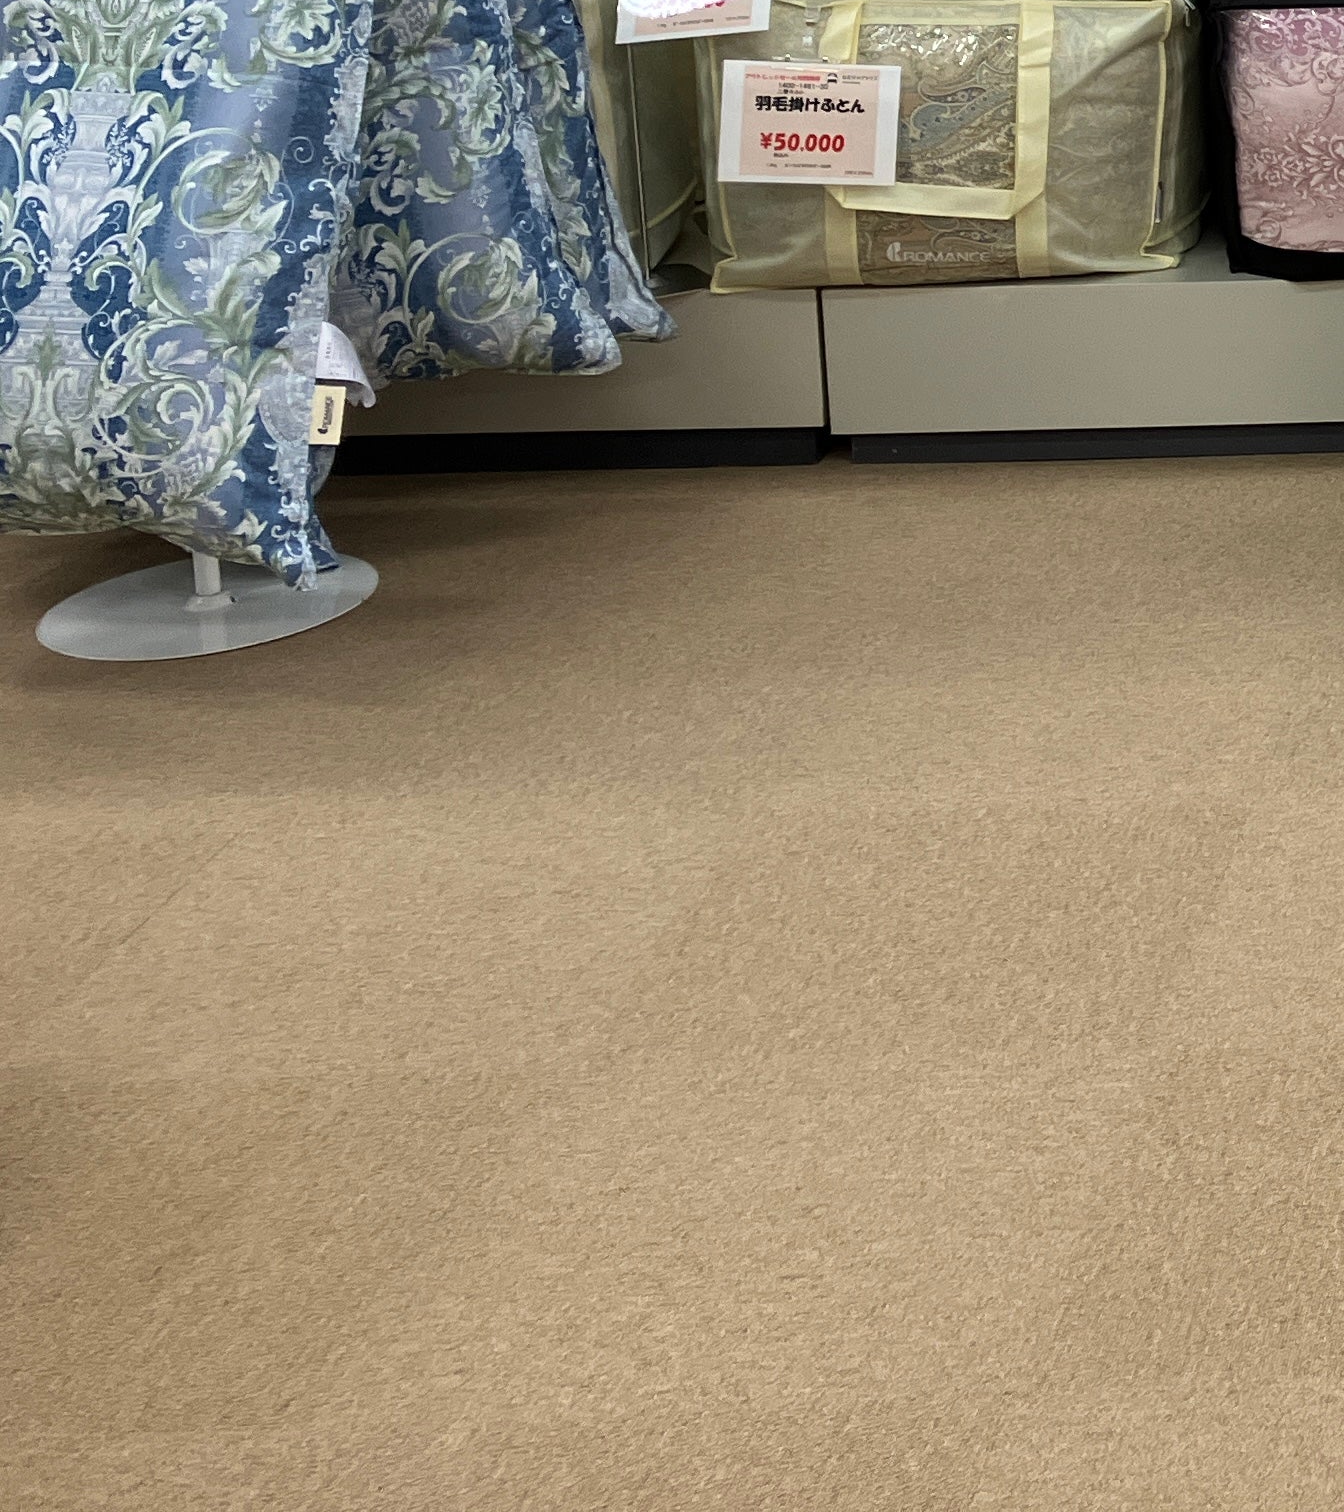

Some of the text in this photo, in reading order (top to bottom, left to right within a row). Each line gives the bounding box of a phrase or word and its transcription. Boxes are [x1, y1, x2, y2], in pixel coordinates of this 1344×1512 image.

[755, 95, 865, 113] 羽毛掛けふとん
[903, 250, 992, 262] ROMANCE
